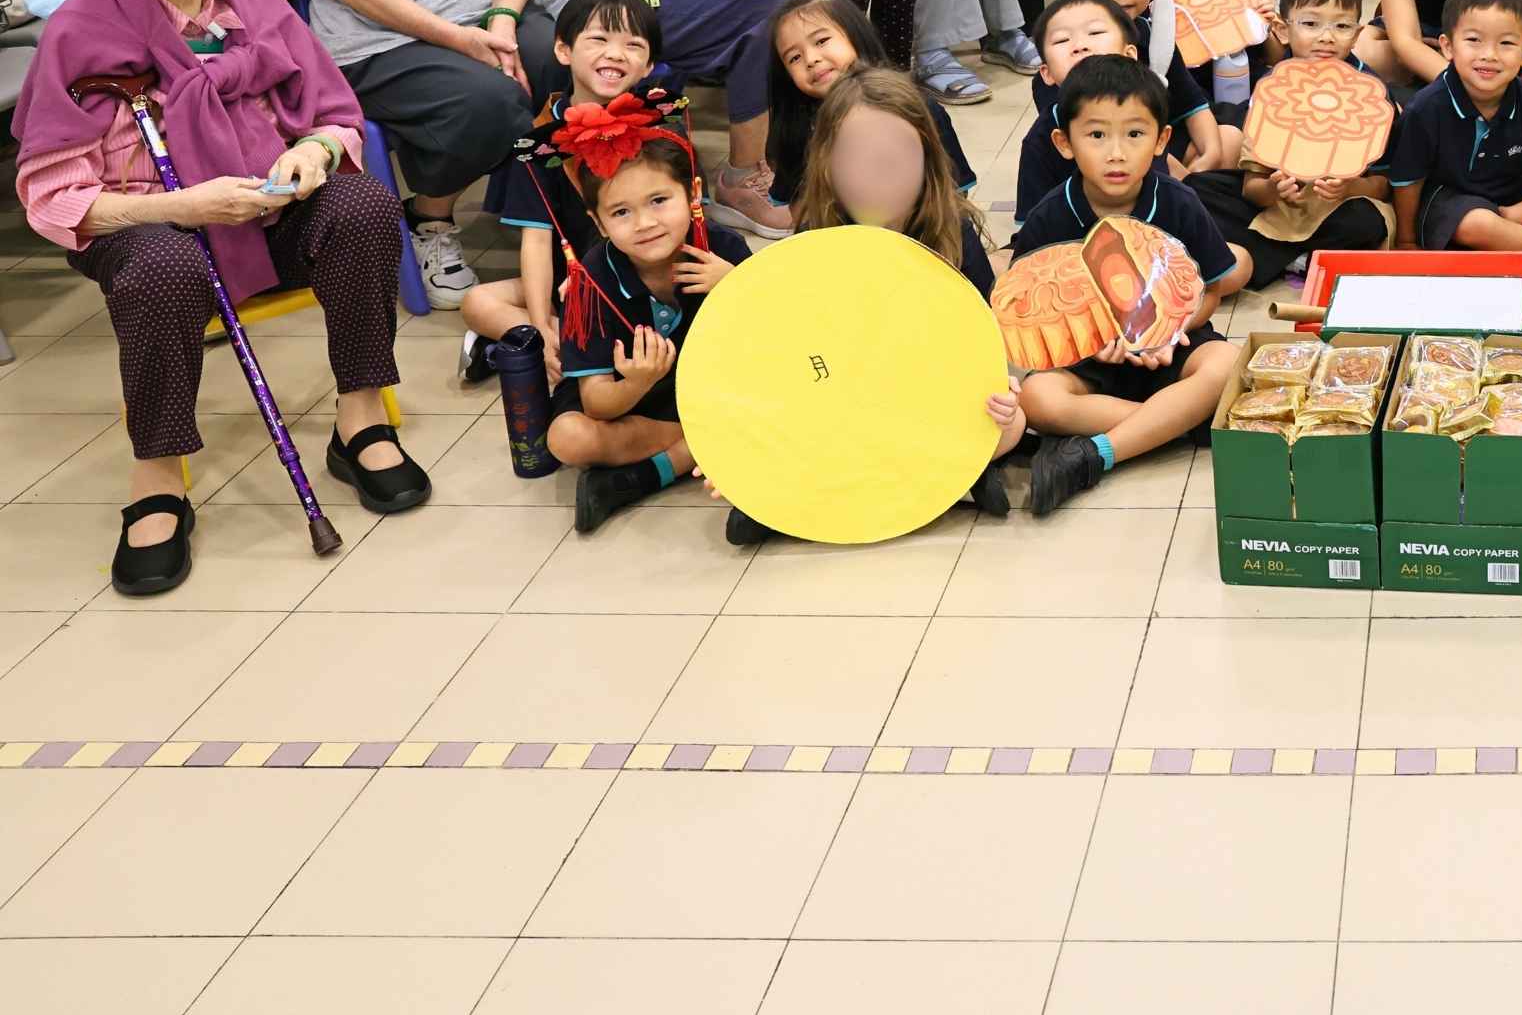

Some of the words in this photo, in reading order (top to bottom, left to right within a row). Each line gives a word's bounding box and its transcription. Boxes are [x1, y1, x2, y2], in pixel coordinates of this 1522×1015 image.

[808, 355, 829, 382] 月
[1241, 539, 1291, 553] NEVIA
[1294, 545, 1323, 554] COPY
[1325, 546, 1360, 555] PAPER
[1399, 542, 1450, 556] NEVIA
[1453, 548, 1482, 557] COPY
[1484, 549, 1520, 558] PAPER
[1243, 558, 1261, 570] A4
[1267, 560, 1284, 571] 80
[1400, 563, 1418, 575] A4
[1425, 564, 1442, 576] 80
